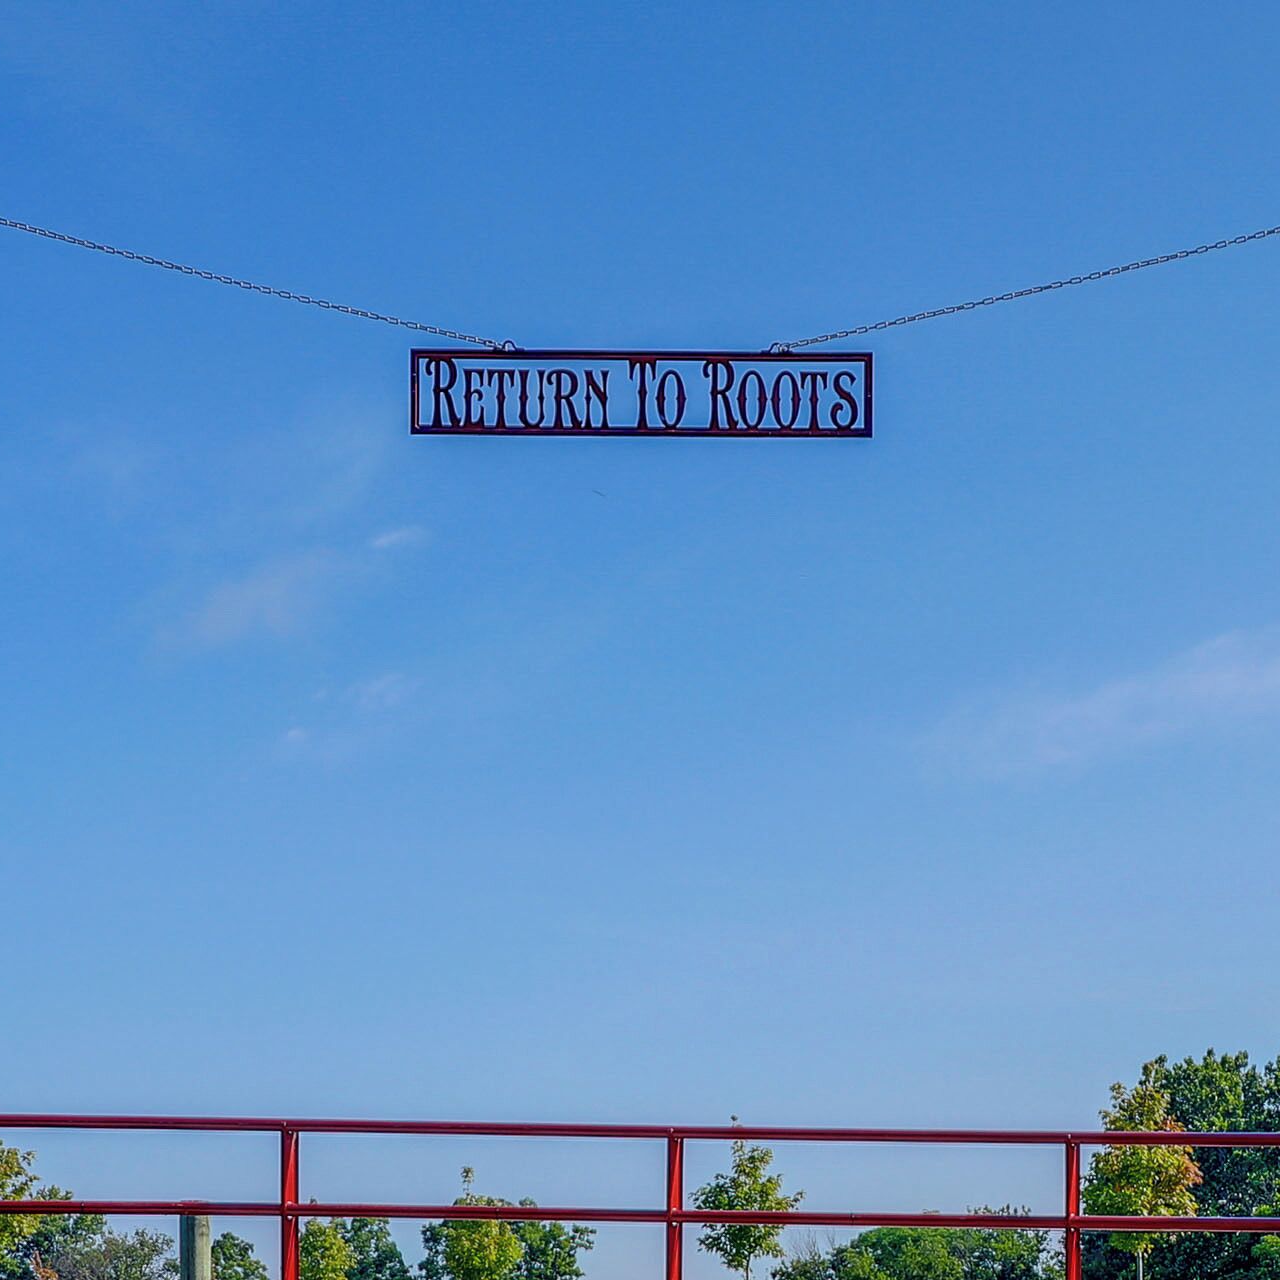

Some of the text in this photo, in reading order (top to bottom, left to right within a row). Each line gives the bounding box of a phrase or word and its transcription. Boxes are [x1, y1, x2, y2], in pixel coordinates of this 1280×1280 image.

[425, 357, 858, 431] RETURN TO ROOTS
